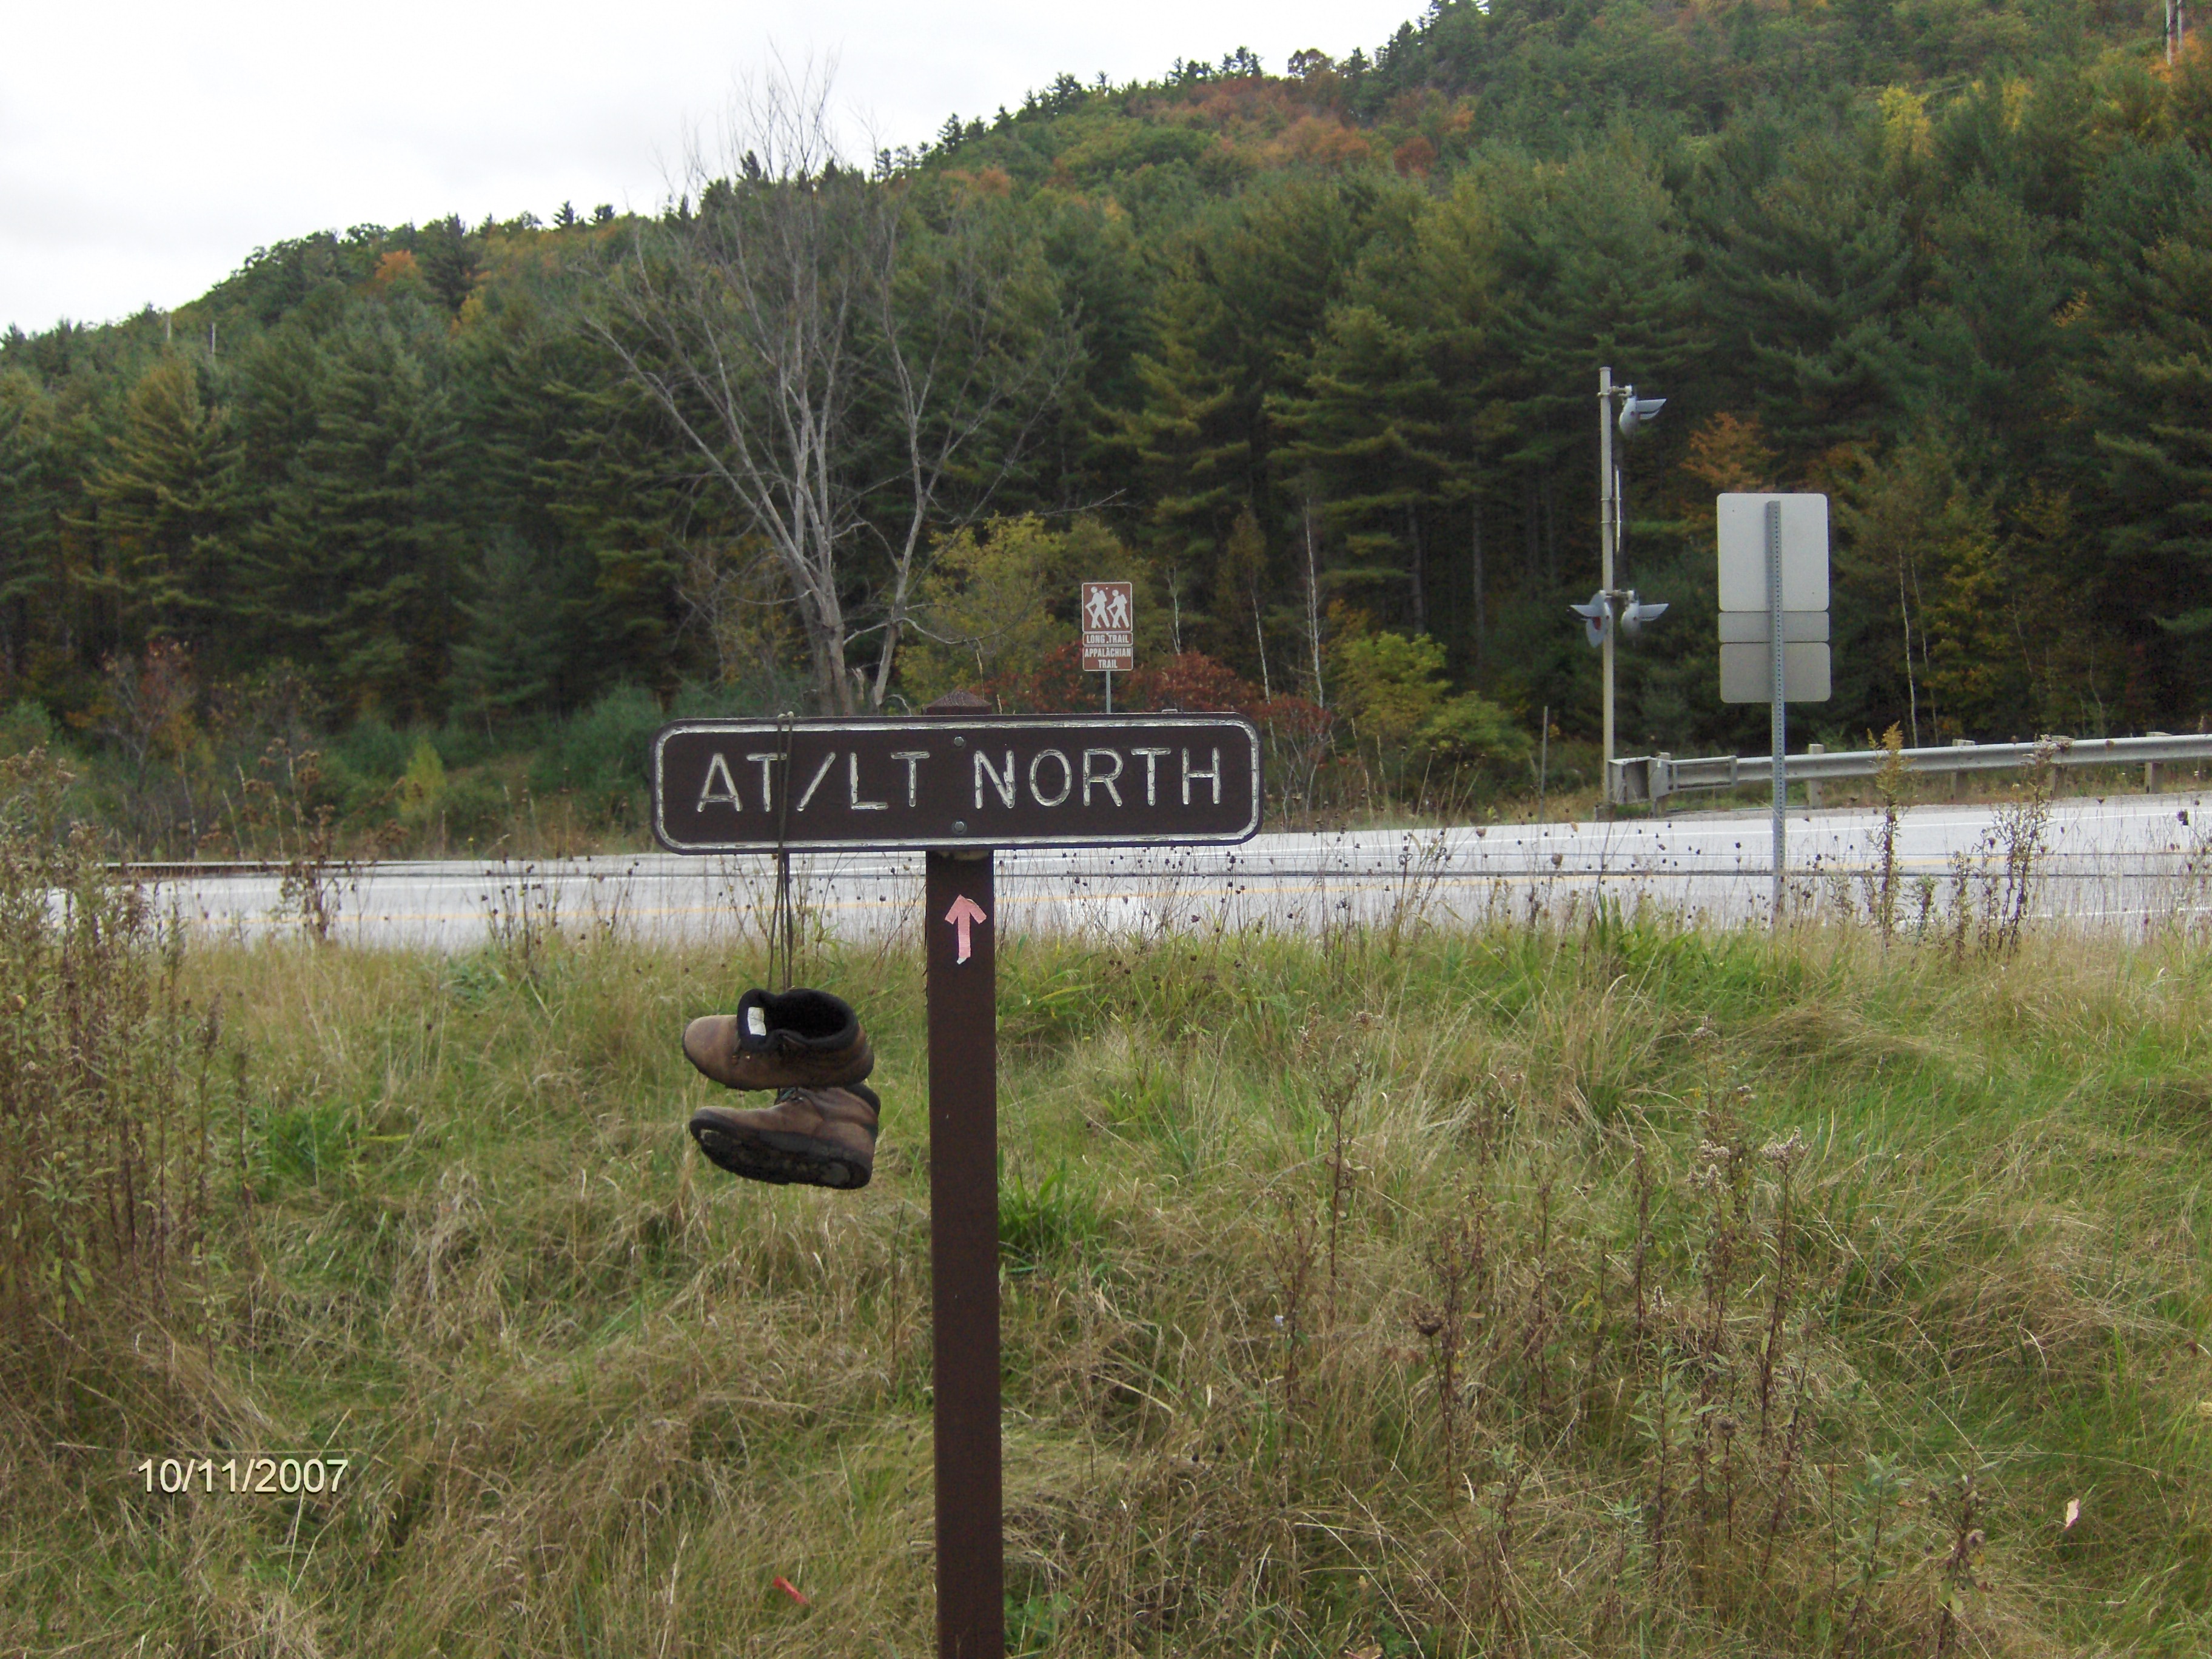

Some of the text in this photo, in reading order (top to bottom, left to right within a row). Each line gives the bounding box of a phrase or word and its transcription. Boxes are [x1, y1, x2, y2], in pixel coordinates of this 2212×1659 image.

[1087, 634, 1129, 643] LONG TRAIL
[1085, 648, 1131, 657] APPALACHIAN
[1098, 660, 1118, 668] TRAIL
[974, 746, 1221, 809] NORTH
